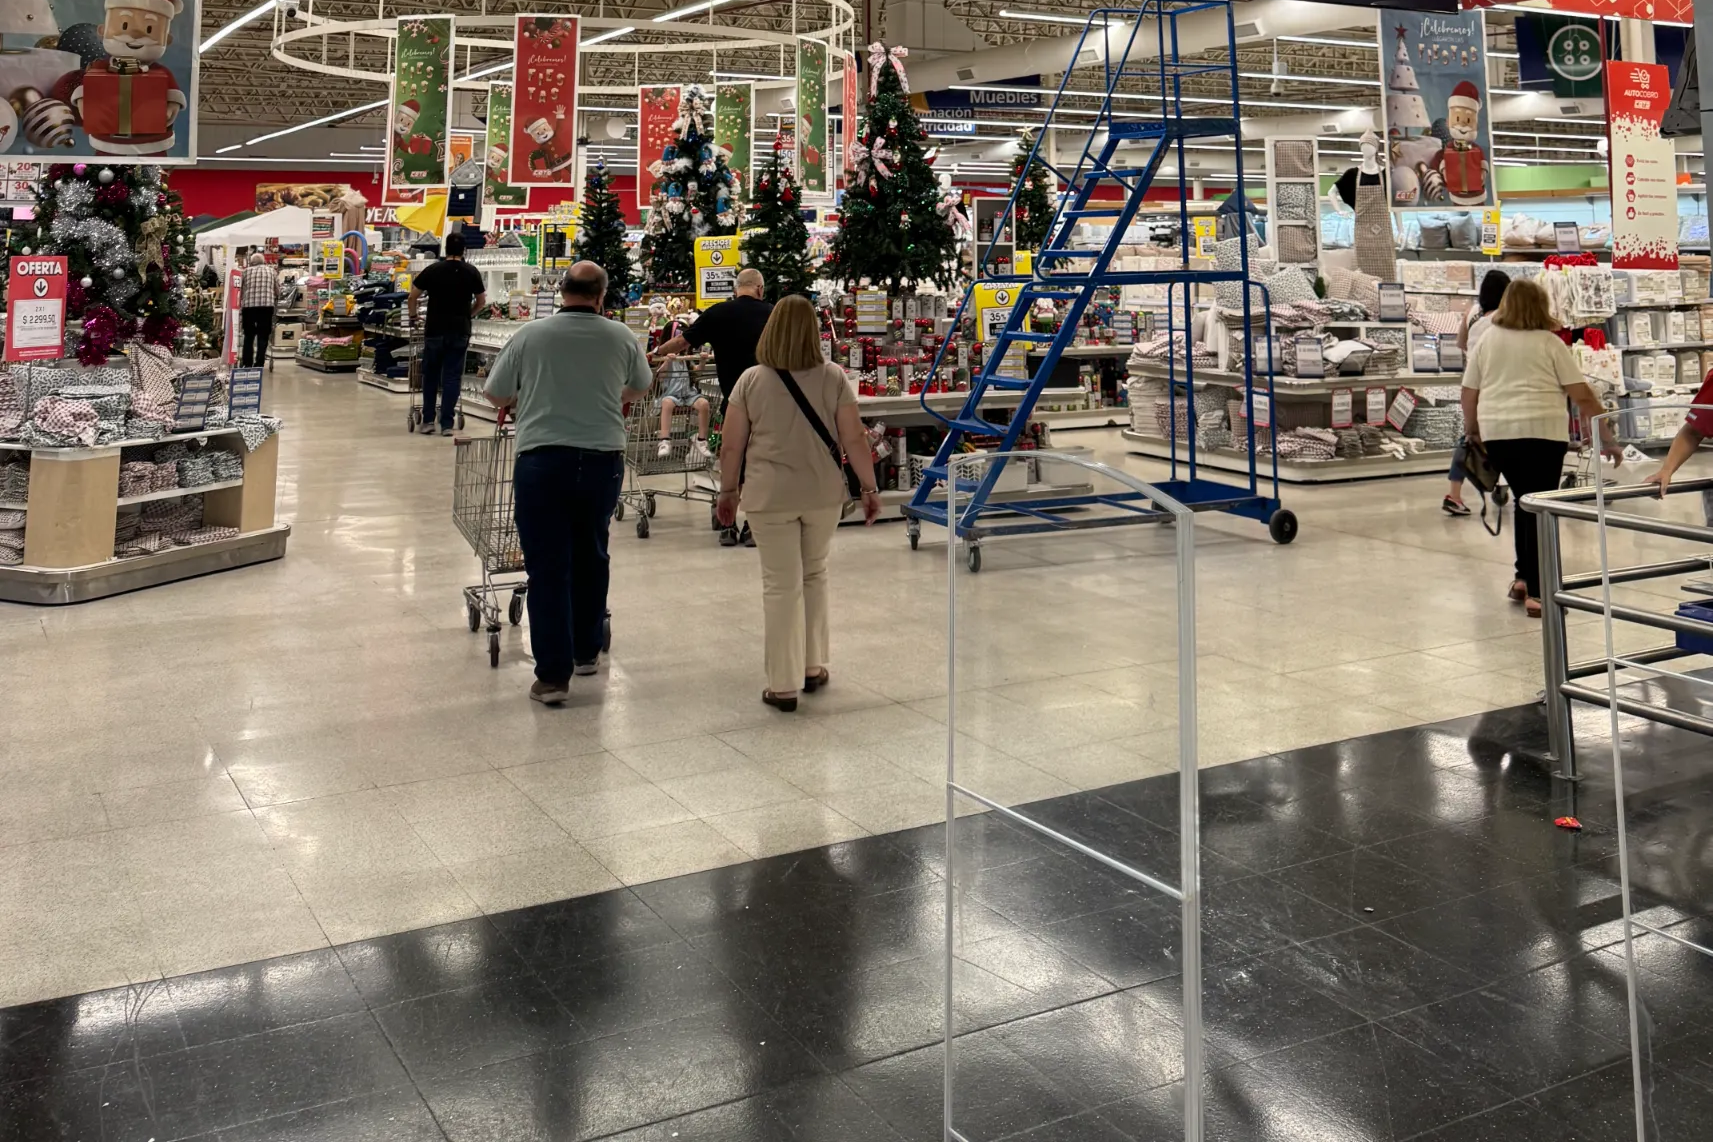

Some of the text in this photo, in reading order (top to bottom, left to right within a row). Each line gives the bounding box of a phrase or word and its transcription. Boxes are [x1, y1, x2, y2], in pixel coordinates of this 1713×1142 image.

[1418, 43, 1478, 67] FIESTAS
[528, 68, 566, 86] FIES
[527, 87, 560, 103] TAS
[969, 90, 1038, 104] Muebles
[16, 260, 63, 276] OFERTA
